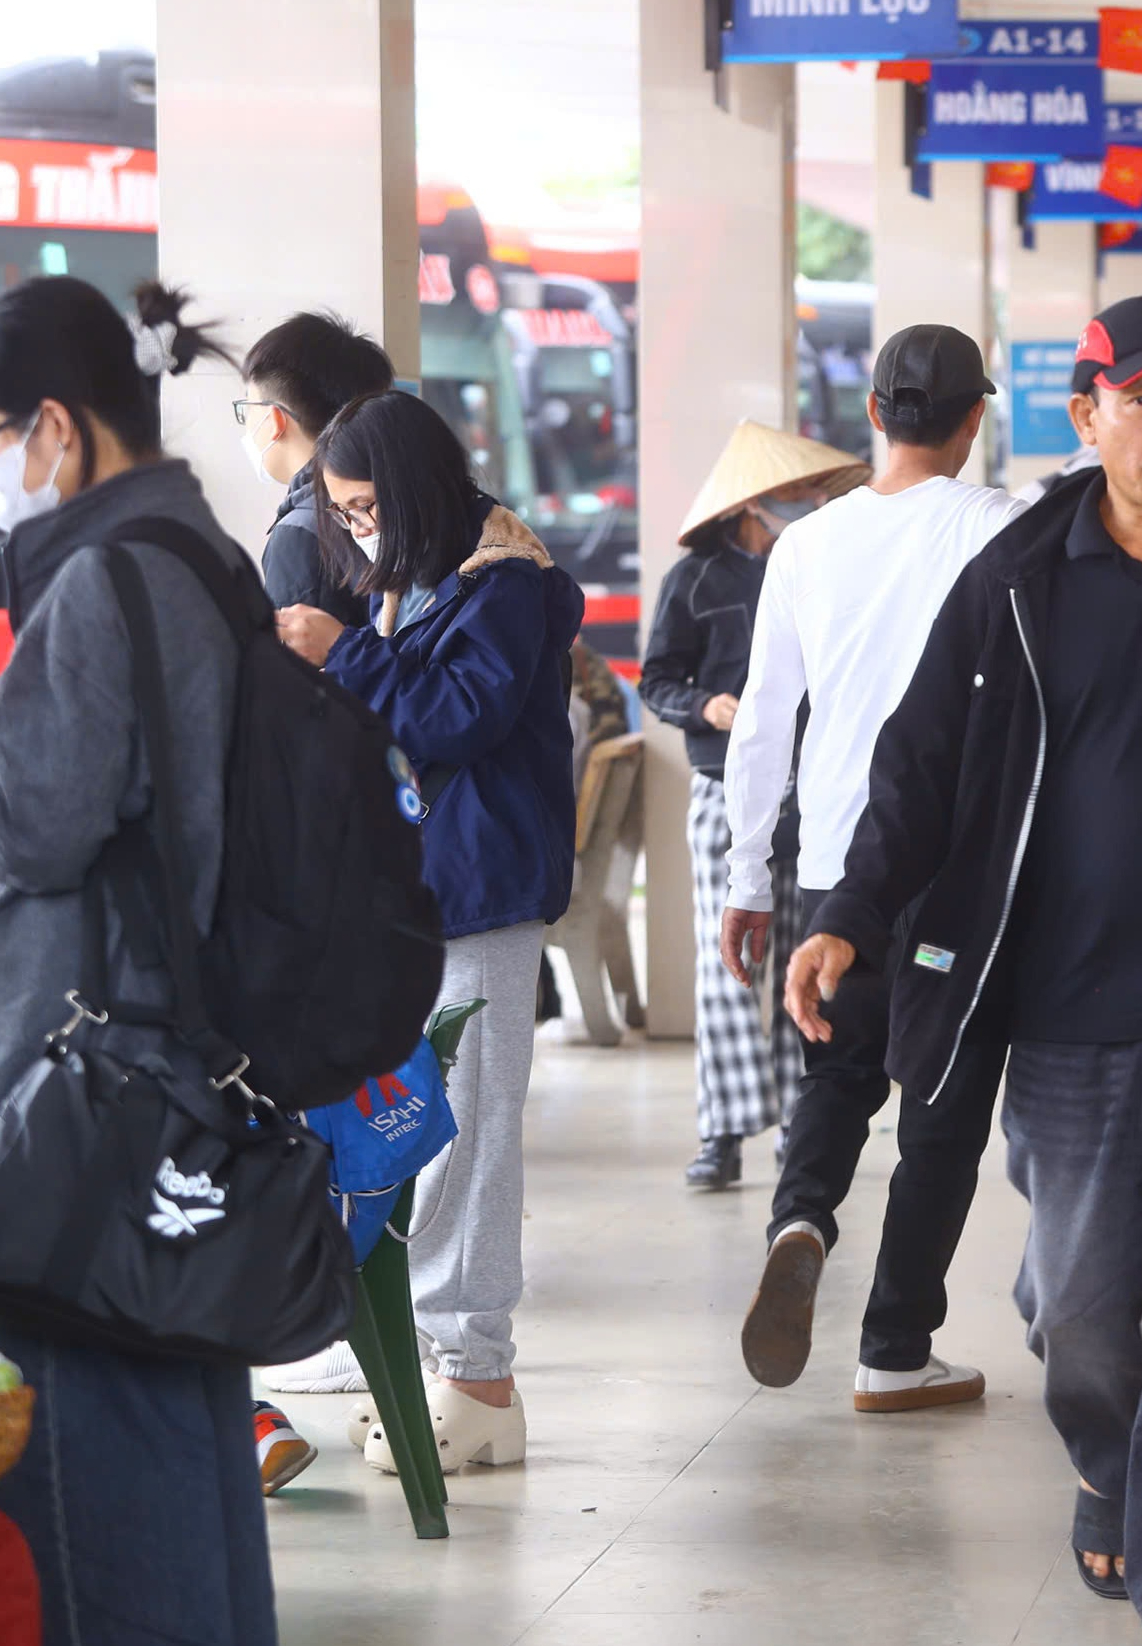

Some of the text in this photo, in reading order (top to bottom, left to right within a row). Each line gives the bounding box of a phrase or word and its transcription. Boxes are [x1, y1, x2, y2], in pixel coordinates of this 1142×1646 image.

[988, 28, 1087, 54] A1-14
[30, 146, 157, 228] THẮN
[385, 1118, 422, 1143] INTECC
[155, 1154, 230, 1206] Reebo
